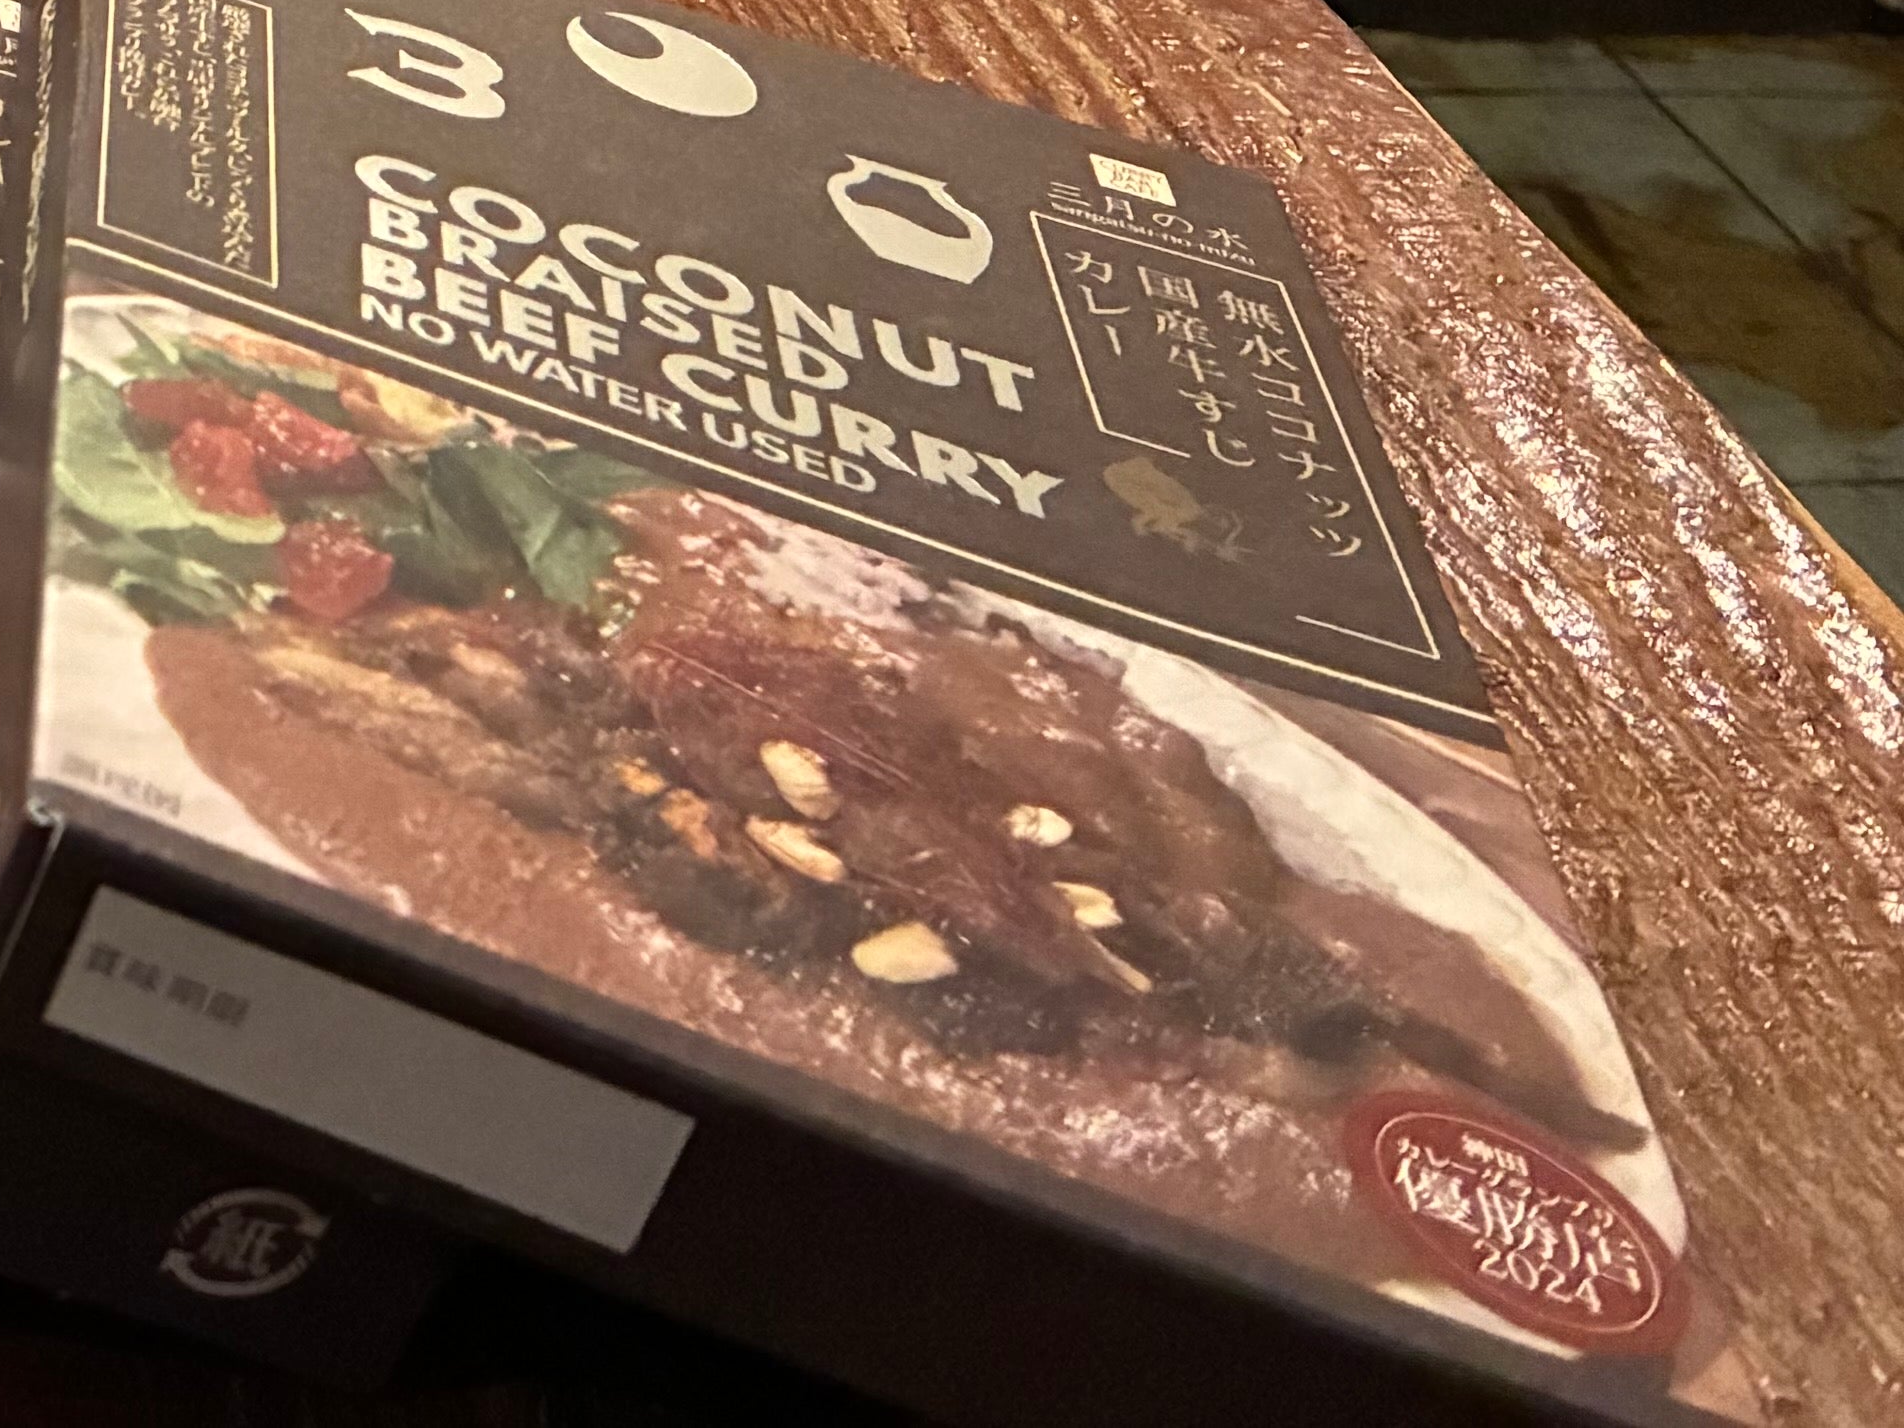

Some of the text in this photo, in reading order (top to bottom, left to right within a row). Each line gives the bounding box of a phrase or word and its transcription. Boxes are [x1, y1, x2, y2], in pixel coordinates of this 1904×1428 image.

[355, 155, 1034, 411] COCONUT
[369, 198, 848, 389] BRAISED
[1048, 181, 1249, 250] 三月の水
[1064, 251, 1131, 357] カレー
[361, 243, 1063, 518] BEEF CURRY
[361, 293, 875, 491] NO WATER USED
[1217, 290, 1362, 557] 無水ココナッツ
[1474, 1239, 1602, 1313] 2024
